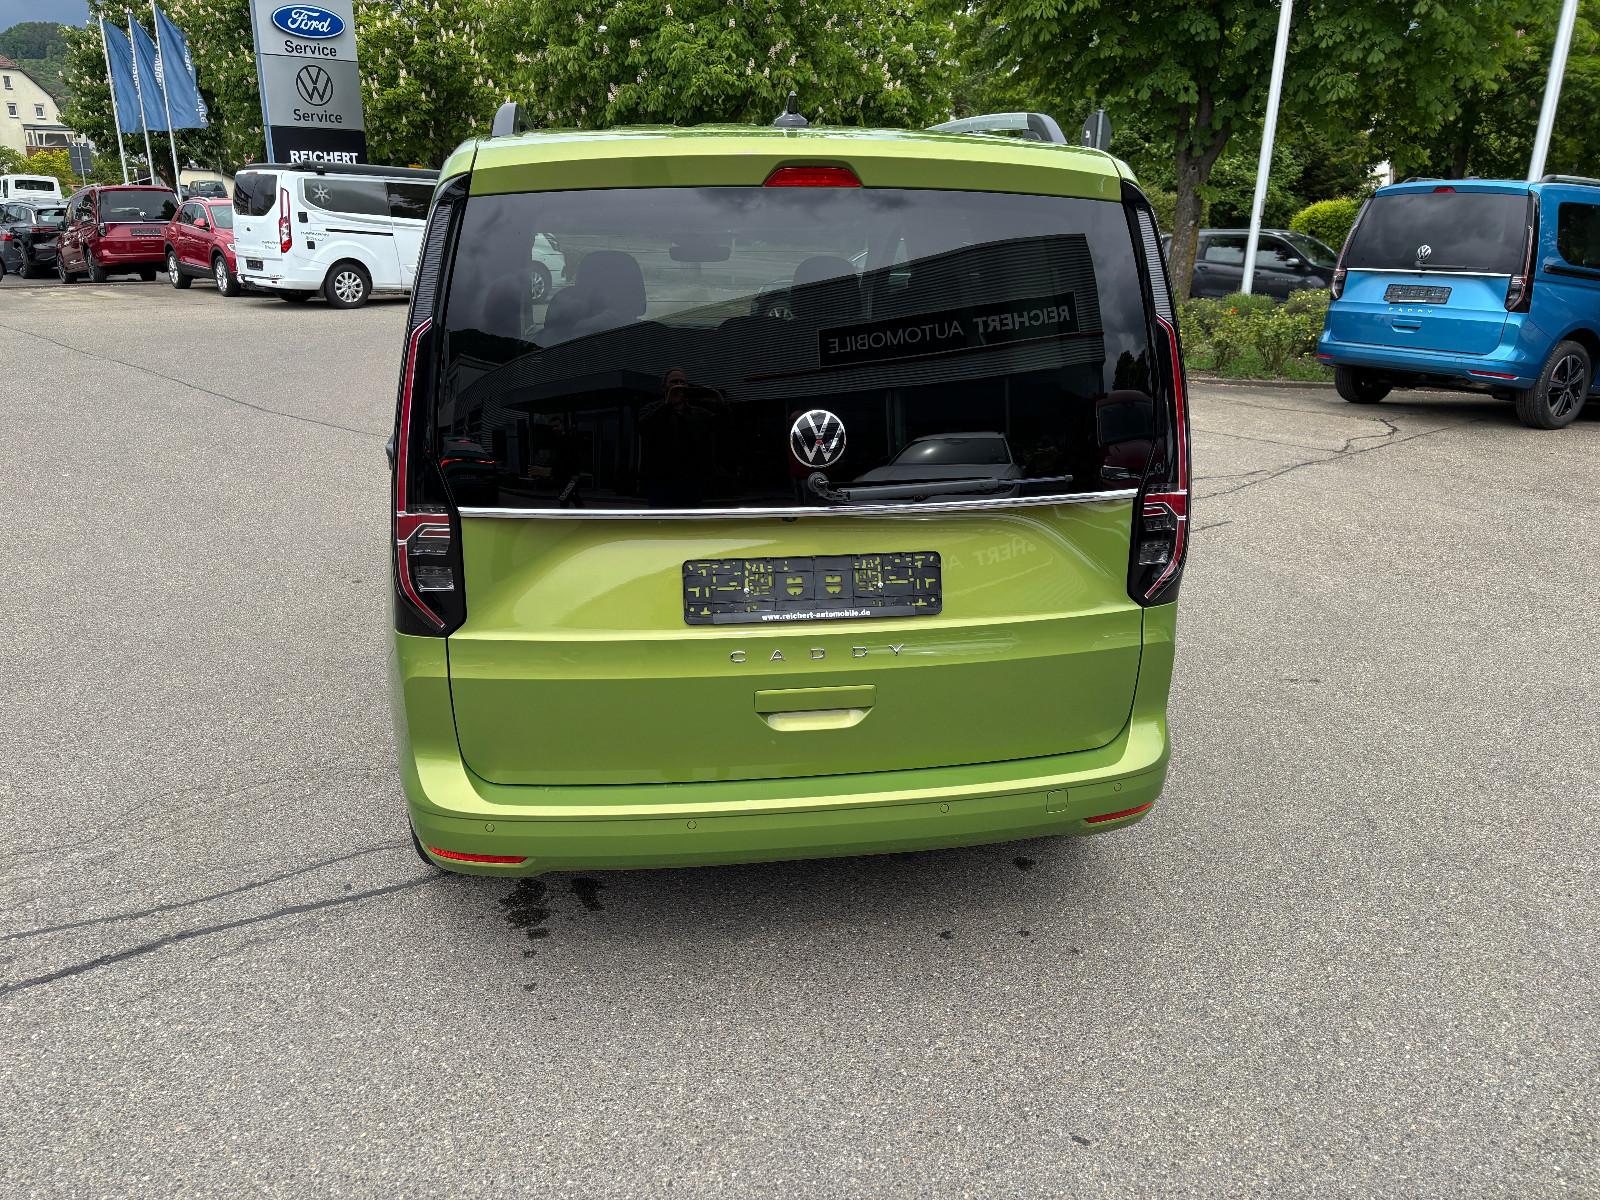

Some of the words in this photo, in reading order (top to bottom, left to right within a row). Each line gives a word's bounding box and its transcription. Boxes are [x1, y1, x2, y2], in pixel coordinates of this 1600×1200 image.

[287, 9, 332, 33] Ford
[284, 40, 337, 57] Service
[296, 65, 333, 105] VW
[293, 109, 343, 124] Service
[289, 150, 359, 165] REICHERT
[792, 410, 845, 466] VW
[761, 609, 871, 621] www.reichert-automobile.de
[729, 643, 905, 663] CADDY
